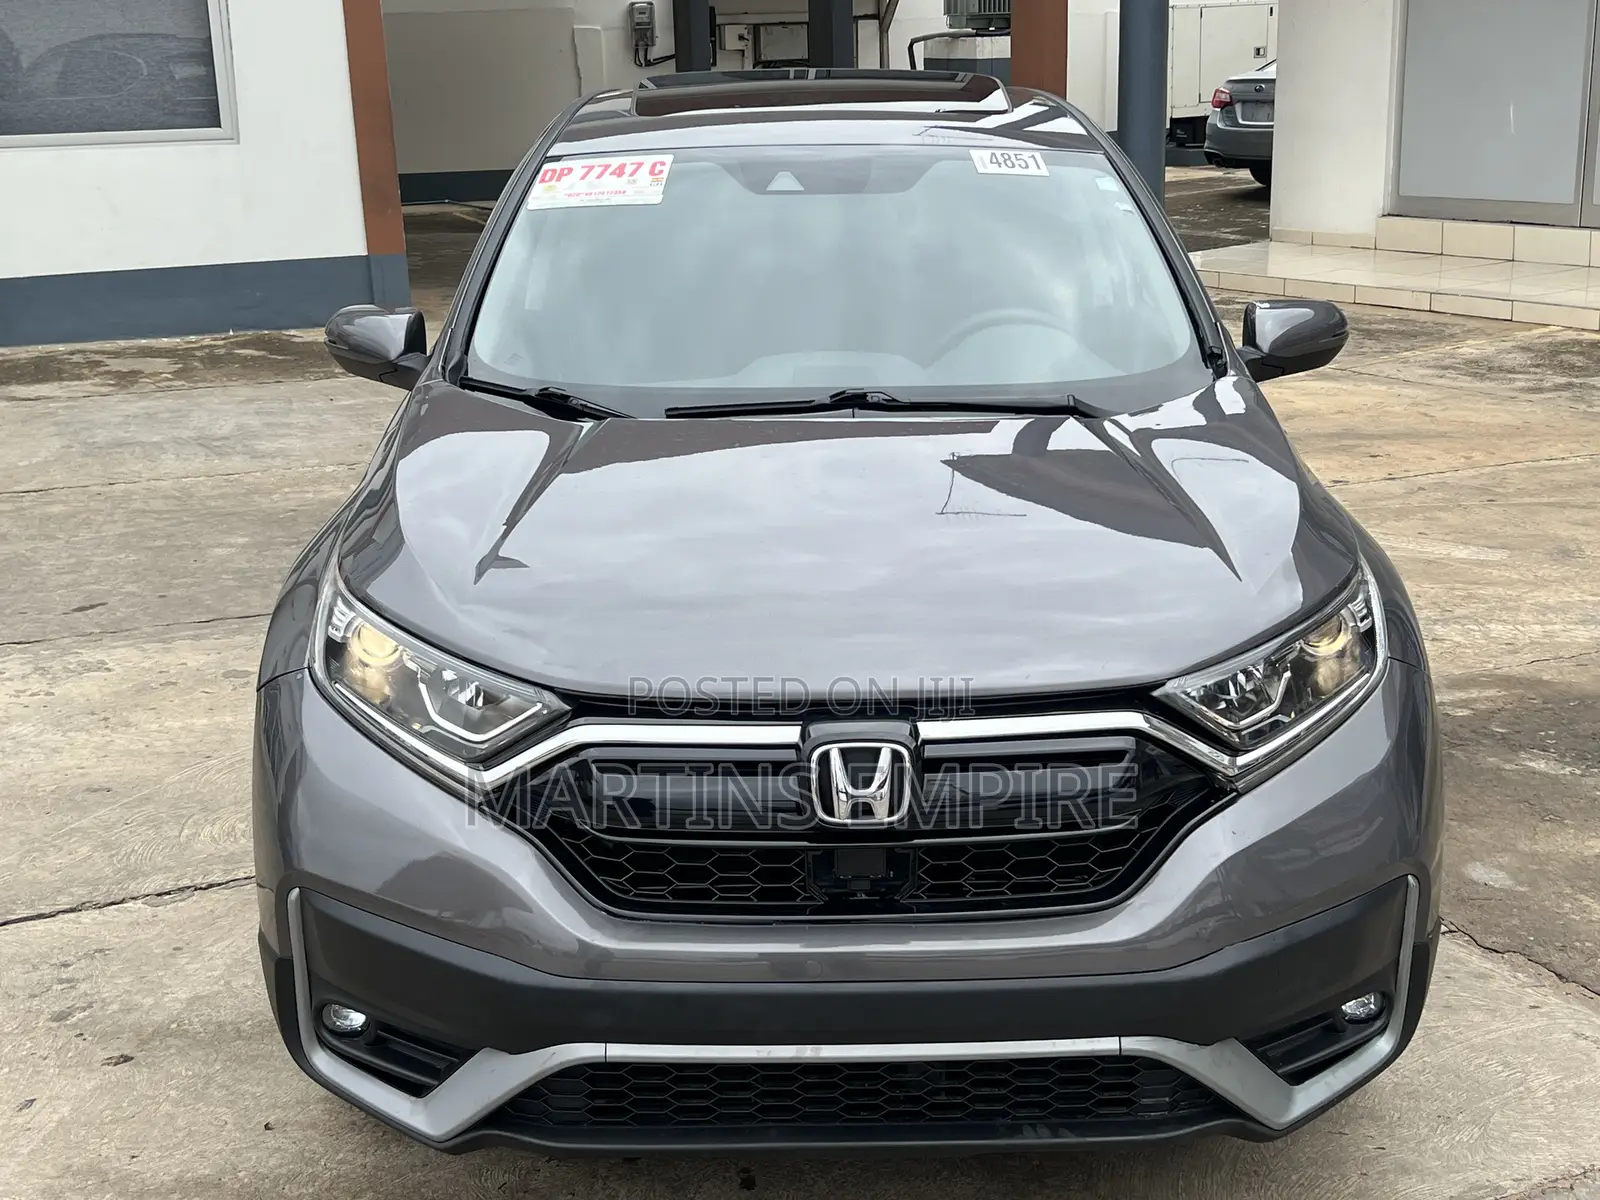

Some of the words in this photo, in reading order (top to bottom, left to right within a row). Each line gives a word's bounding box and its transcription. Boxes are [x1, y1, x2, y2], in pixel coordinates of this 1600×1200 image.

[538, 167, 574, 184] DP
[579, 161, 645, 181] 7747
[648, 160, 667, 177] C
[989, 152, 1042, 171] 4851
